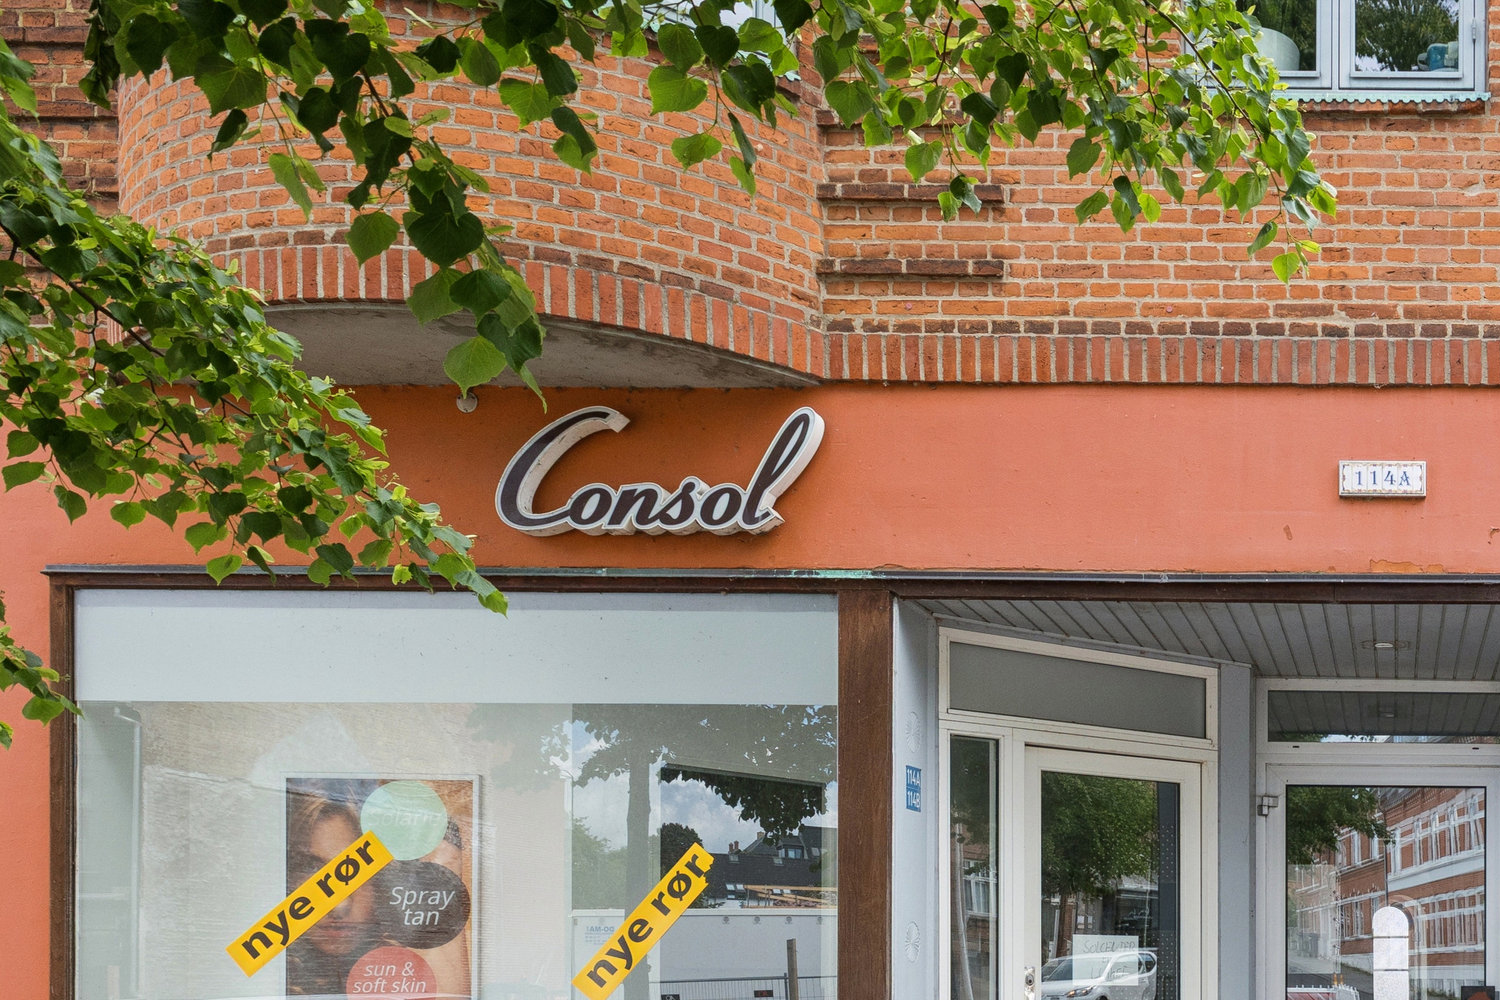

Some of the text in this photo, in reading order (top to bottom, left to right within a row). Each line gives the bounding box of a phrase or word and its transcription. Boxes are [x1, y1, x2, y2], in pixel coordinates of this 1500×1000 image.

[494, 405, 826, 537] Consol
[1355, 471, 1410, 486] 114A
[242, 841, 375, 960] nye rør
[389, 886, 455, 910] Spray
[403, 910, 440, 926] tan
[586, 918, 654, 988] nye
[650, 853, 705, 917] rør
[363, 962, 415, 976] sun &
[353, 977, 426, 993] soft skin
